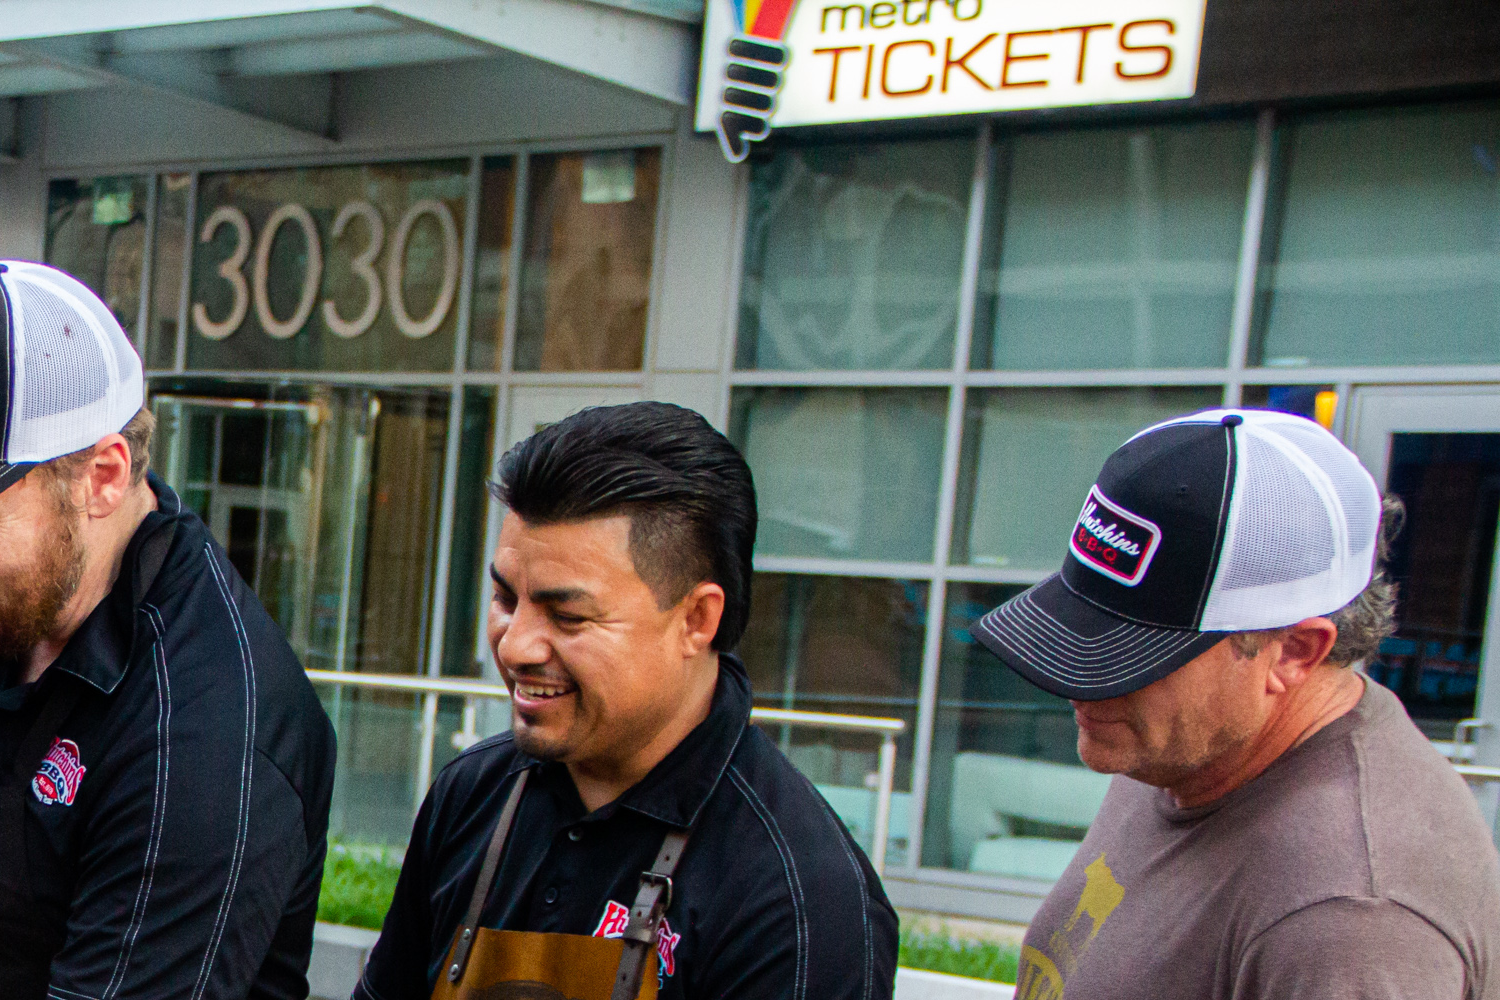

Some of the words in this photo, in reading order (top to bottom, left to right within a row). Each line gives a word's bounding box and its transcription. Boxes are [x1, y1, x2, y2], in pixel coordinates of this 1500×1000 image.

[820, 0, 983, 33] metro
[813, 19, 1177, 102] TICKETS
[193, 203, 460, 340] 3030
[1079, 502, 1140, 556] Hutchins
